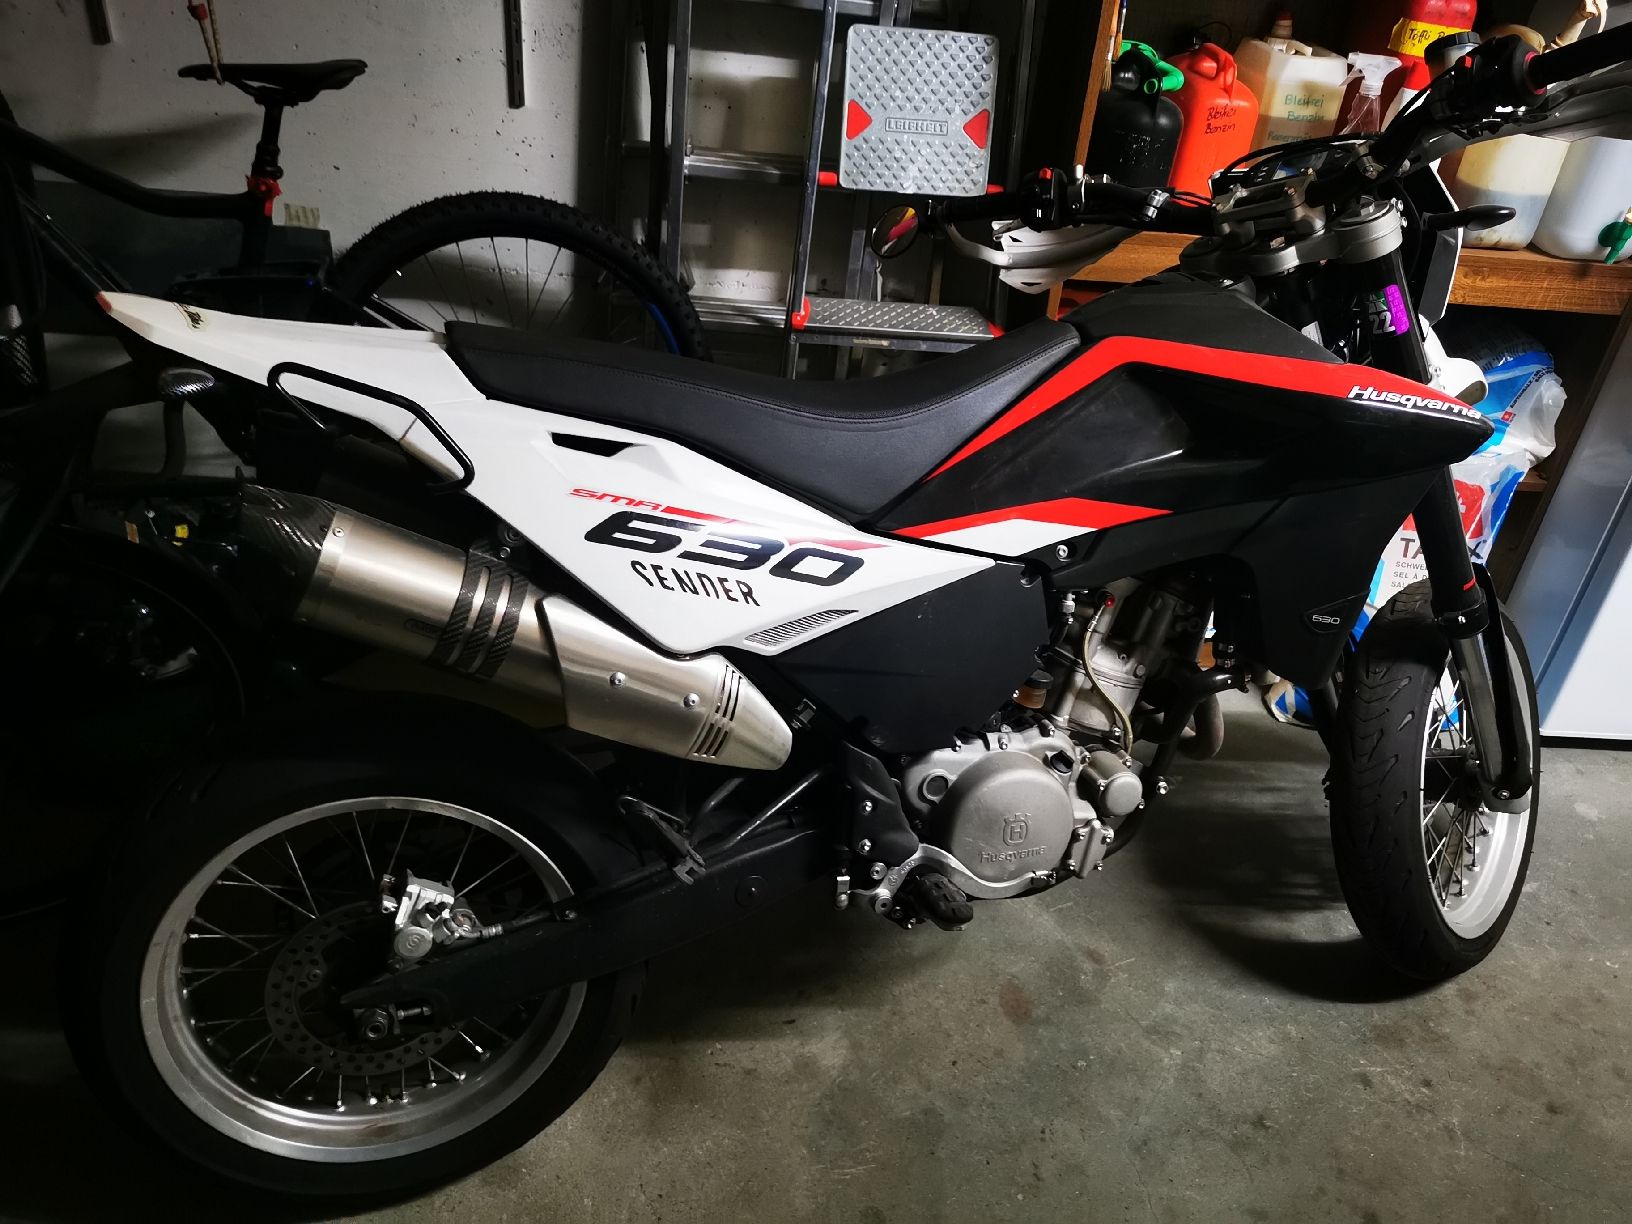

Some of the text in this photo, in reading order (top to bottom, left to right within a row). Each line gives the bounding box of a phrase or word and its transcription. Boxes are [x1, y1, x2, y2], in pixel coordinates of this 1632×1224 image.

[886, 119, 948, 133] LEIFHEIT
[1369, 311, 1396, 334] 22
[1347, 385, 1482, 419] Husqvarna
[569, 488, 662, 511] SMR
[584, 510, 864, 586] 630
[1395, 561, 1428, 570] SCHWE
[630, 559, 760, 607] SENDER
[1312, 614, 1341, 624] 630
[979, 845, 1047, 864] Husqvarna
